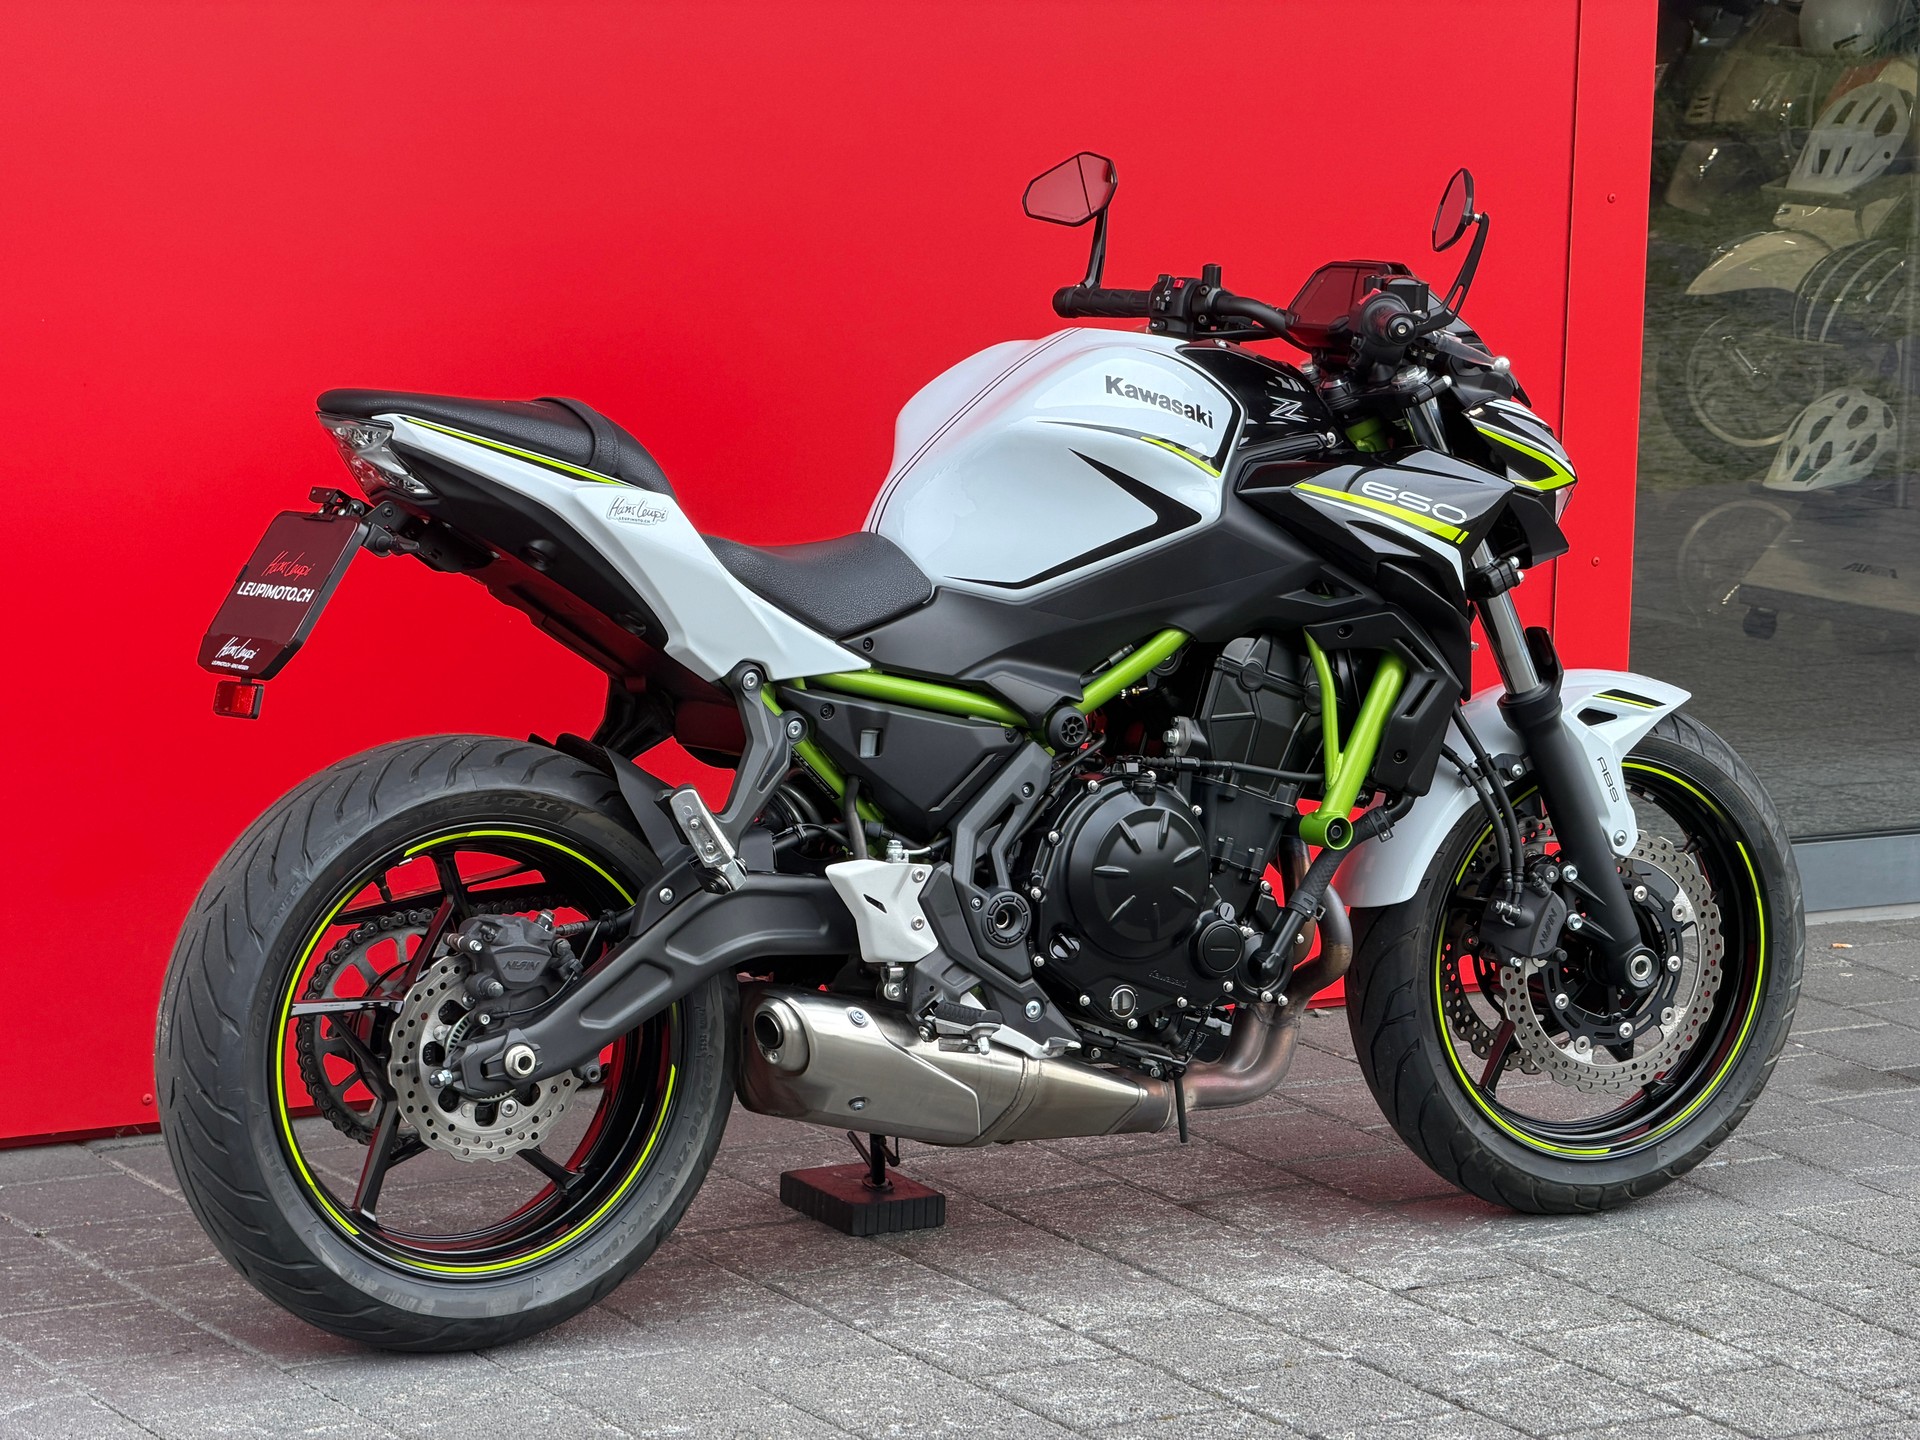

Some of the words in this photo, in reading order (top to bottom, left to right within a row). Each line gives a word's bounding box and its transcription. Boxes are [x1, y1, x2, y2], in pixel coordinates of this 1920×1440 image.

[1105, 375, 1214, 430] Kawasaki
[1268, 395, 1308, 424] Z
[608, 497, 636, 517] Hans
[636, 500, 667, 522] Leupi
[1361, 481, 1468, 525] 650
[284, 551, 316, 582] Leupi
[236, 580, 315, 604] LEUPIMOTO.CH
[1596, 756, 1619, 803] ABS
